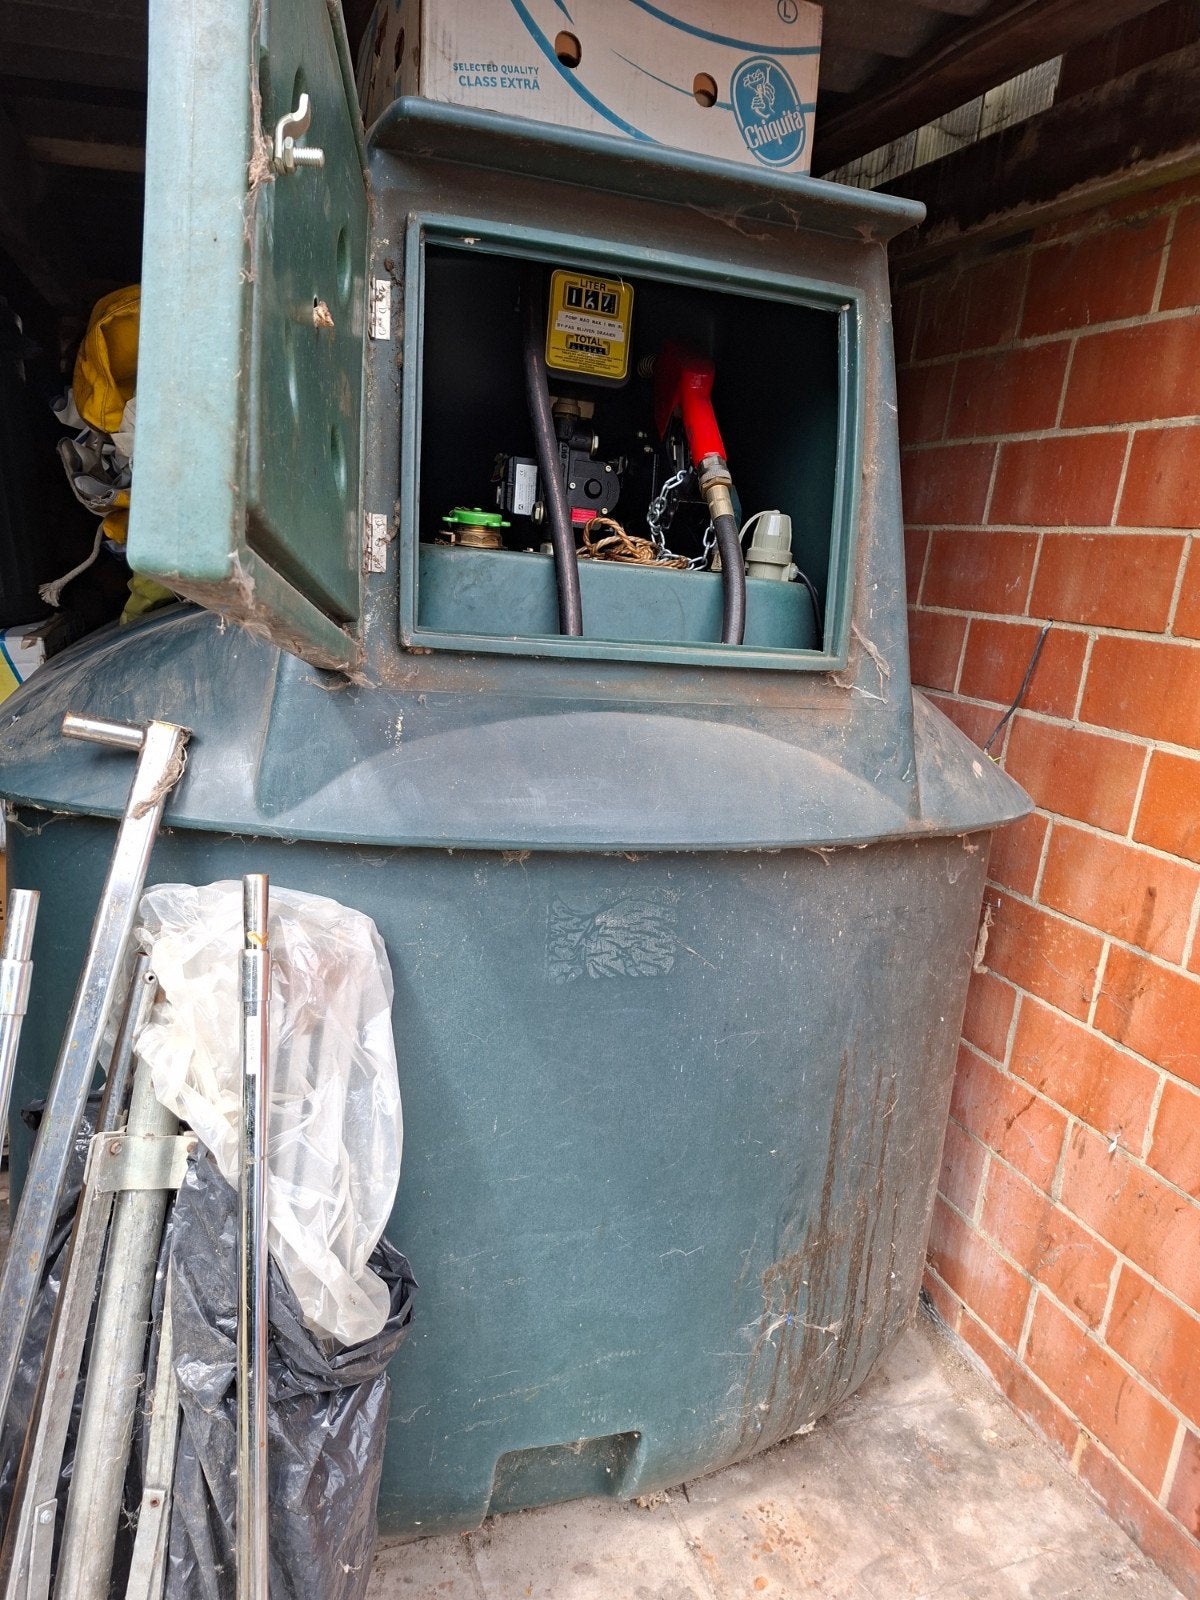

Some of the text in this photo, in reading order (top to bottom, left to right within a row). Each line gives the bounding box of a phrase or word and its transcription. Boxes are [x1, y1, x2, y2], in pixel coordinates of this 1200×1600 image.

[784, 1, 791, 19] L
[453, 62, 539, 75] SELECTED QUALITY
[458, 75, 498, 88] CLASS
[744, 109, 803, 149] Chiquita
[580, 280, 606, 291] LITER
[574, 334, 603, 346] TOTAL
